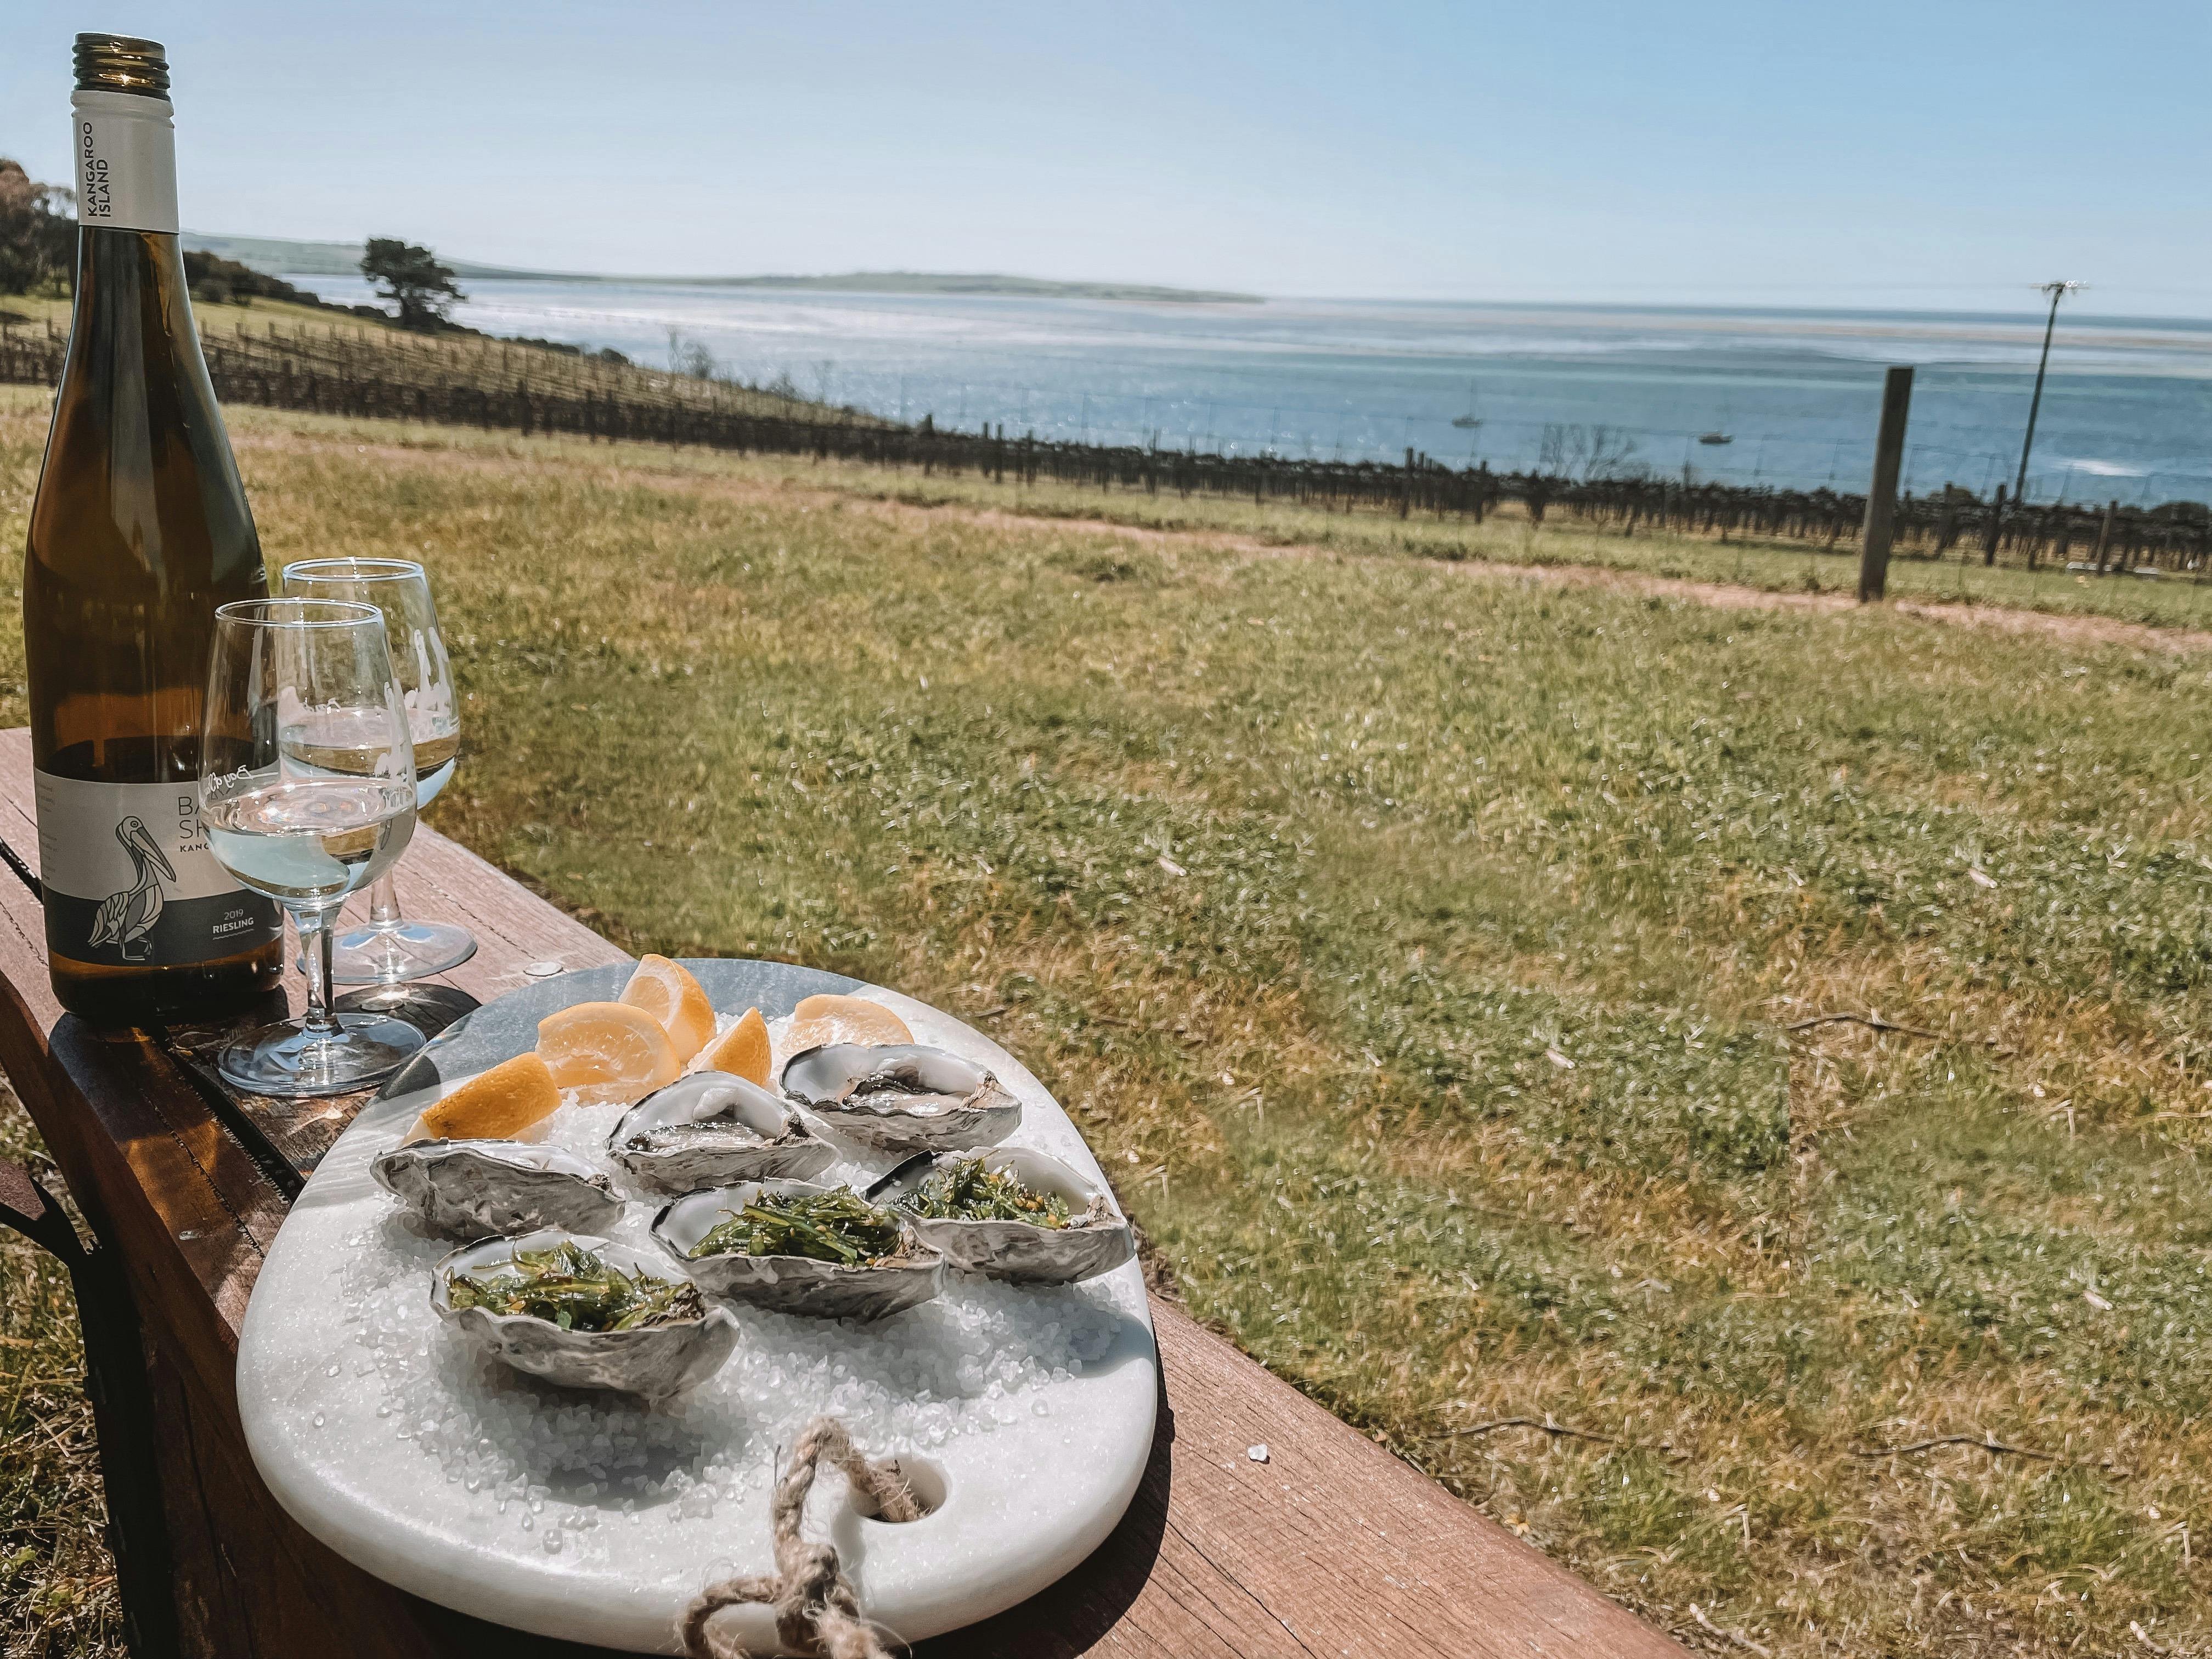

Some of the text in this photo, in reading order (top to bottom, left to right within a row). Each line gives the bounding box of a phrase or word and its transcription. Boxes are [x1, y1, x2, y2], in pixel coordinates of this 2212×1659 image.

[83, 122, 98, 217] KANGAROO
[96, 159, 111, 217] ISLAND
[212, 917, 255, 934] RIESLING
[223, 909, 244, 921] 2019
